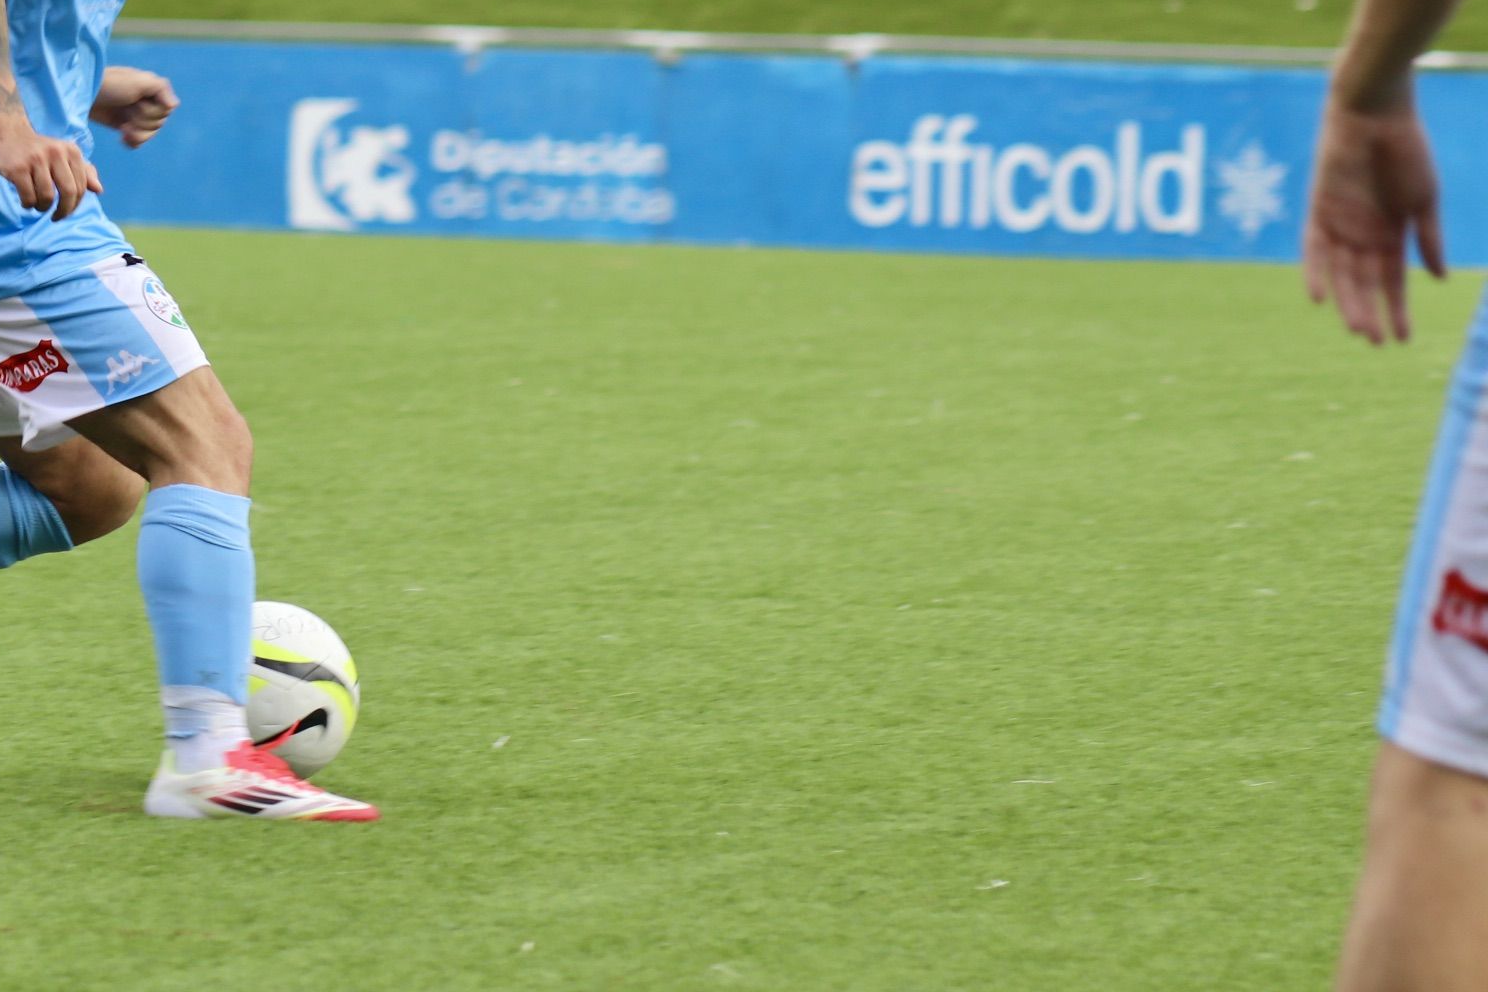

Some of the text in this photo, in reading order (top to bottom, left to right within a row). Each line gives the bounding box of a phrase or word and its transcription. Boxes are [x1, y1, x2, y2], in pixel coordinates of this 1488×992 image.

[430, 127, 668, 181] Diputación
[849, 114, 1206, 235] efficold
[427, 173, 488, 219] de
